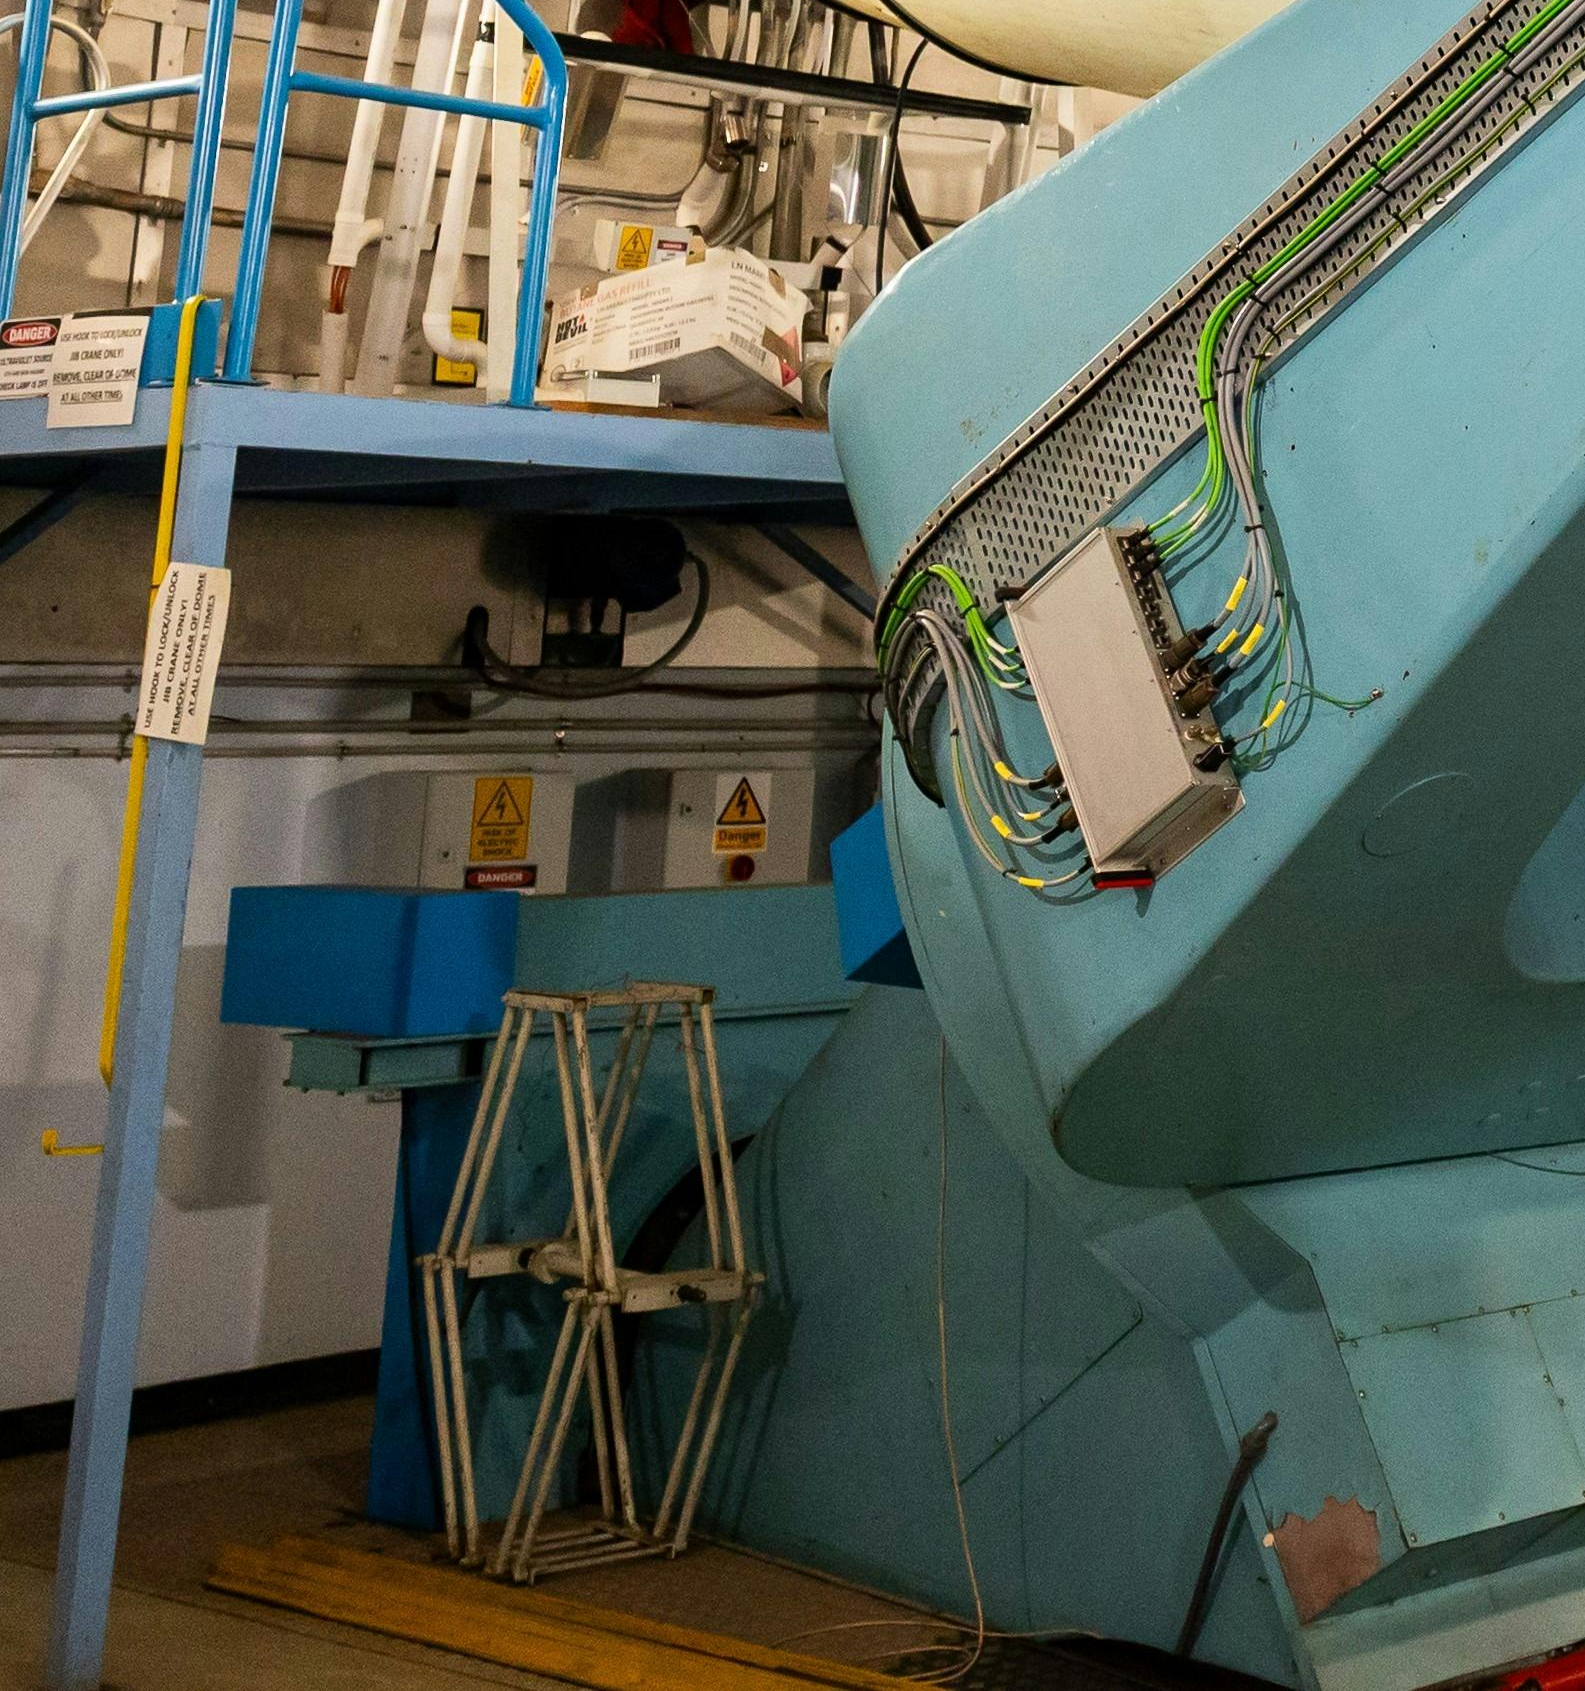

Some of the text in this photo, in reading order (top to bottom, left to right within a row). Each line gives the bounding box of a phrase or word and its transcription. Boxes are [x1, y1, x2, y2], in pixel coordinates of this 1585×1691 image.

[557, 316, 579, 330] HOT
[9, 326, 51, 342] DANGER
[73, 332, 90, 341] HOOK
[555, 323, 587, 344] DEVIL
[81, 350, 102, 360] CRANE
[83, 370, 104, 382] CLEAR
[82, 391, 102, 401] OTHER
[194, 572, 207, 611] DOME
[190, 612, 199, 630] OF
[145, 570, 179, 728] USE HOOK TO LOCK/UNLOCK
[167, 641, 182, 683] CRANE
[176, 598, 188, 638] ONLY!
[183, 634, 196, 673] CLEAR
[188, 594, 216, 716] AT ALL OTHER TIMES
[478, 872, 523, 883] DANGER
